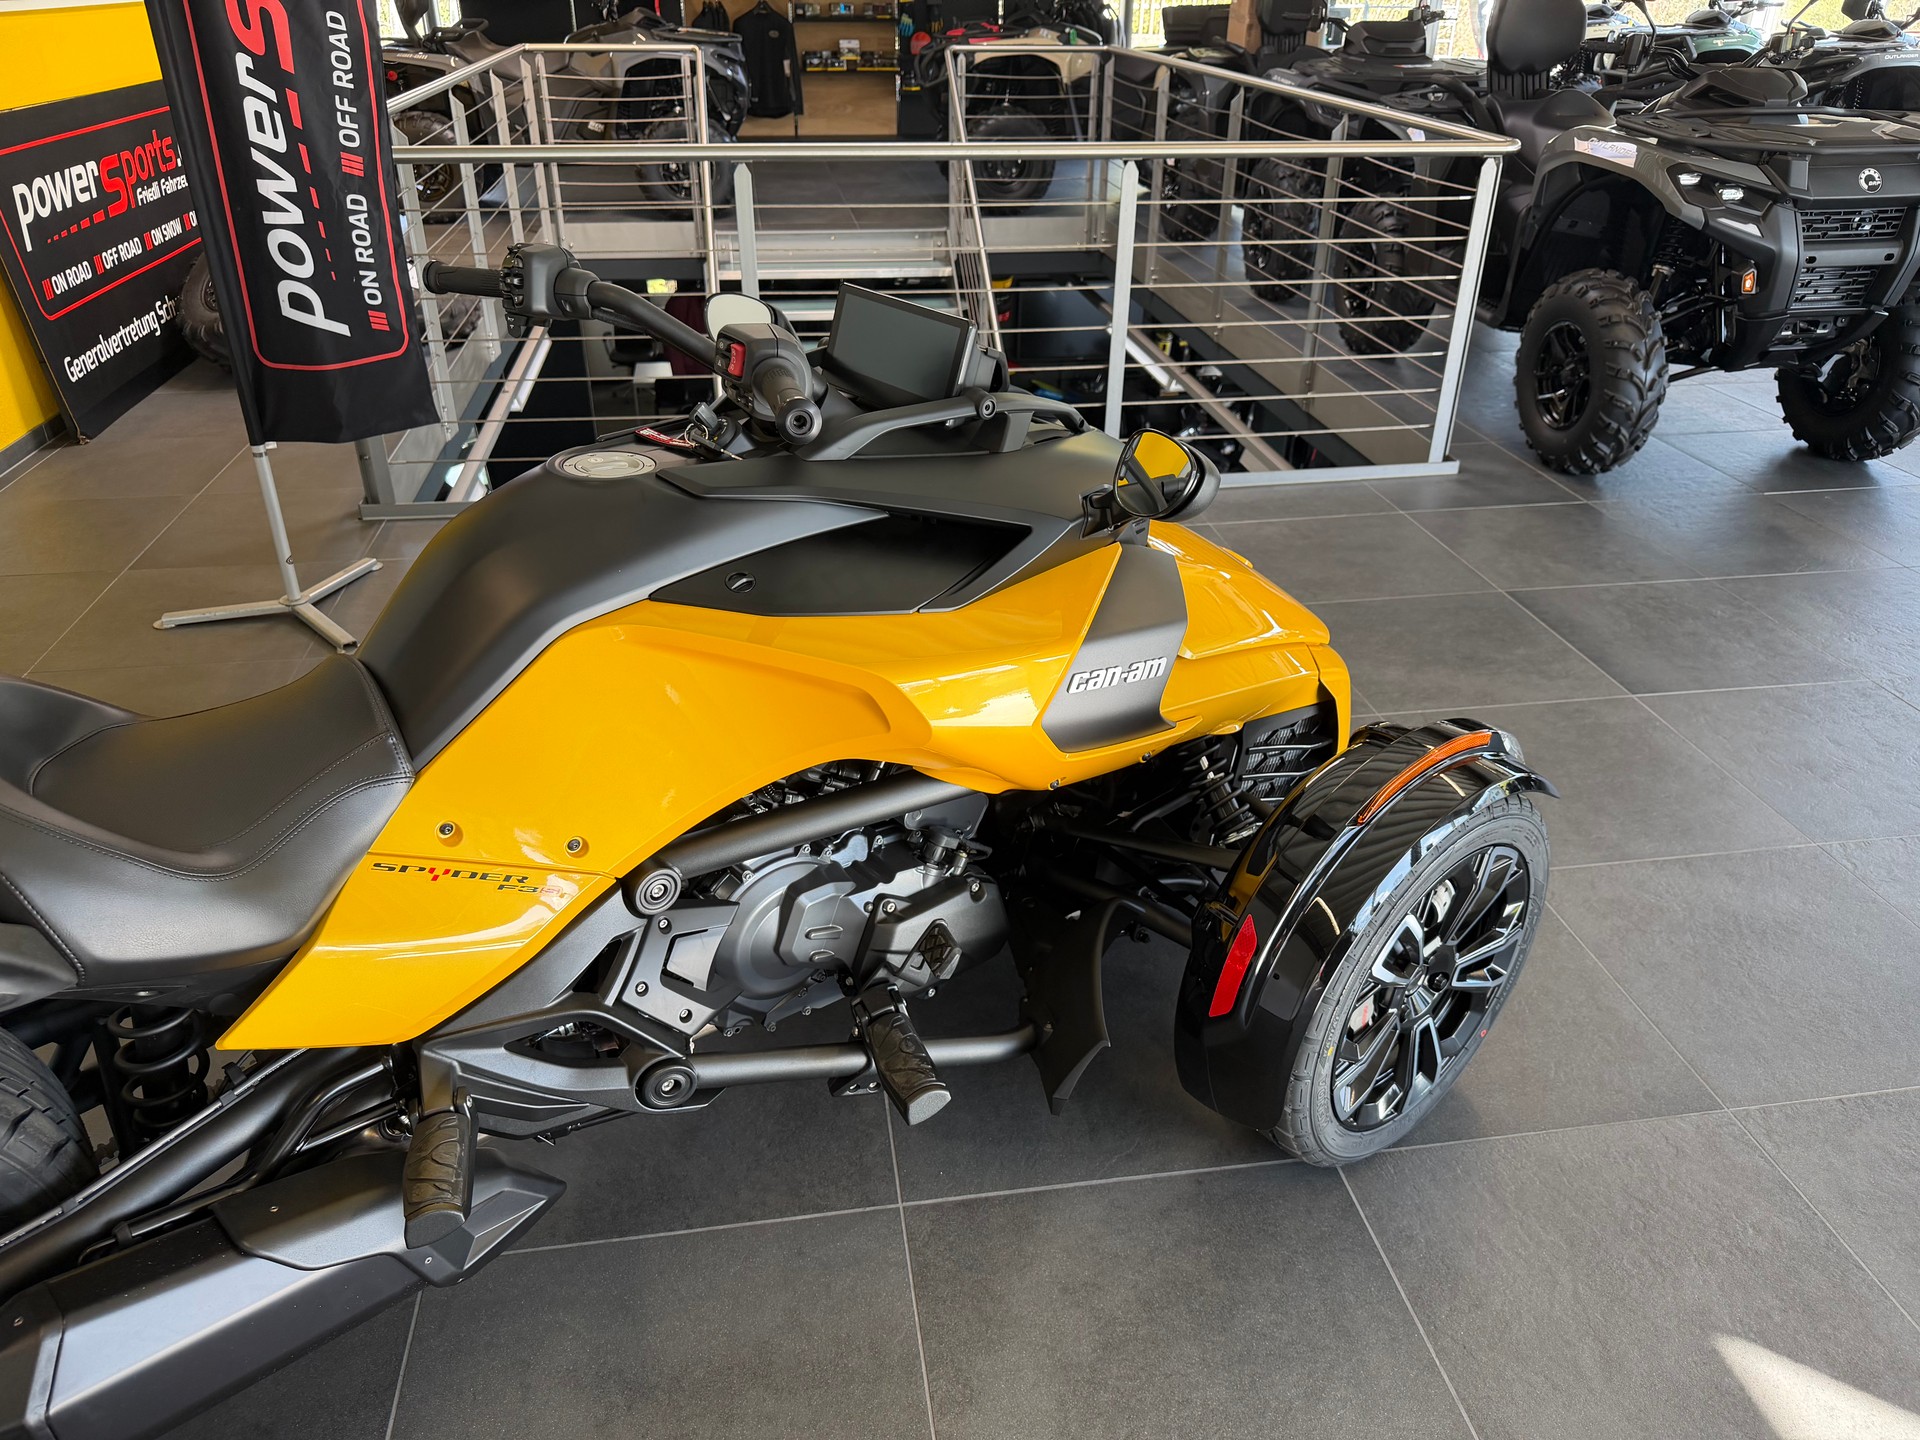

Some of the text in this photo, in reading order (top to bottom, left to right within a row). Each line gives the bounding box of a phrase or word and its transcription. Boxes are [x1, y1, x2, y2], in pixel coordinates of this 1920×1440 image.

[325, 10, 383, 306] ON ROAD OFF ROAD
[136, 180, 161, 206] Friedli
[51, 272, 68, 295] ON
[65, 260, 93, 288] ROAD
[101, 247, 119, 270] OFF
[117, 236, 143, 262] ROAD
[150, 226, 165, 246] ON
[161, 217, 182, 241] SNOW
[64, 311, 161, 383] Generalvertretung
[1066, 656, 1168, 694] can-am
[370, 861, 530, 884] SPYDER
